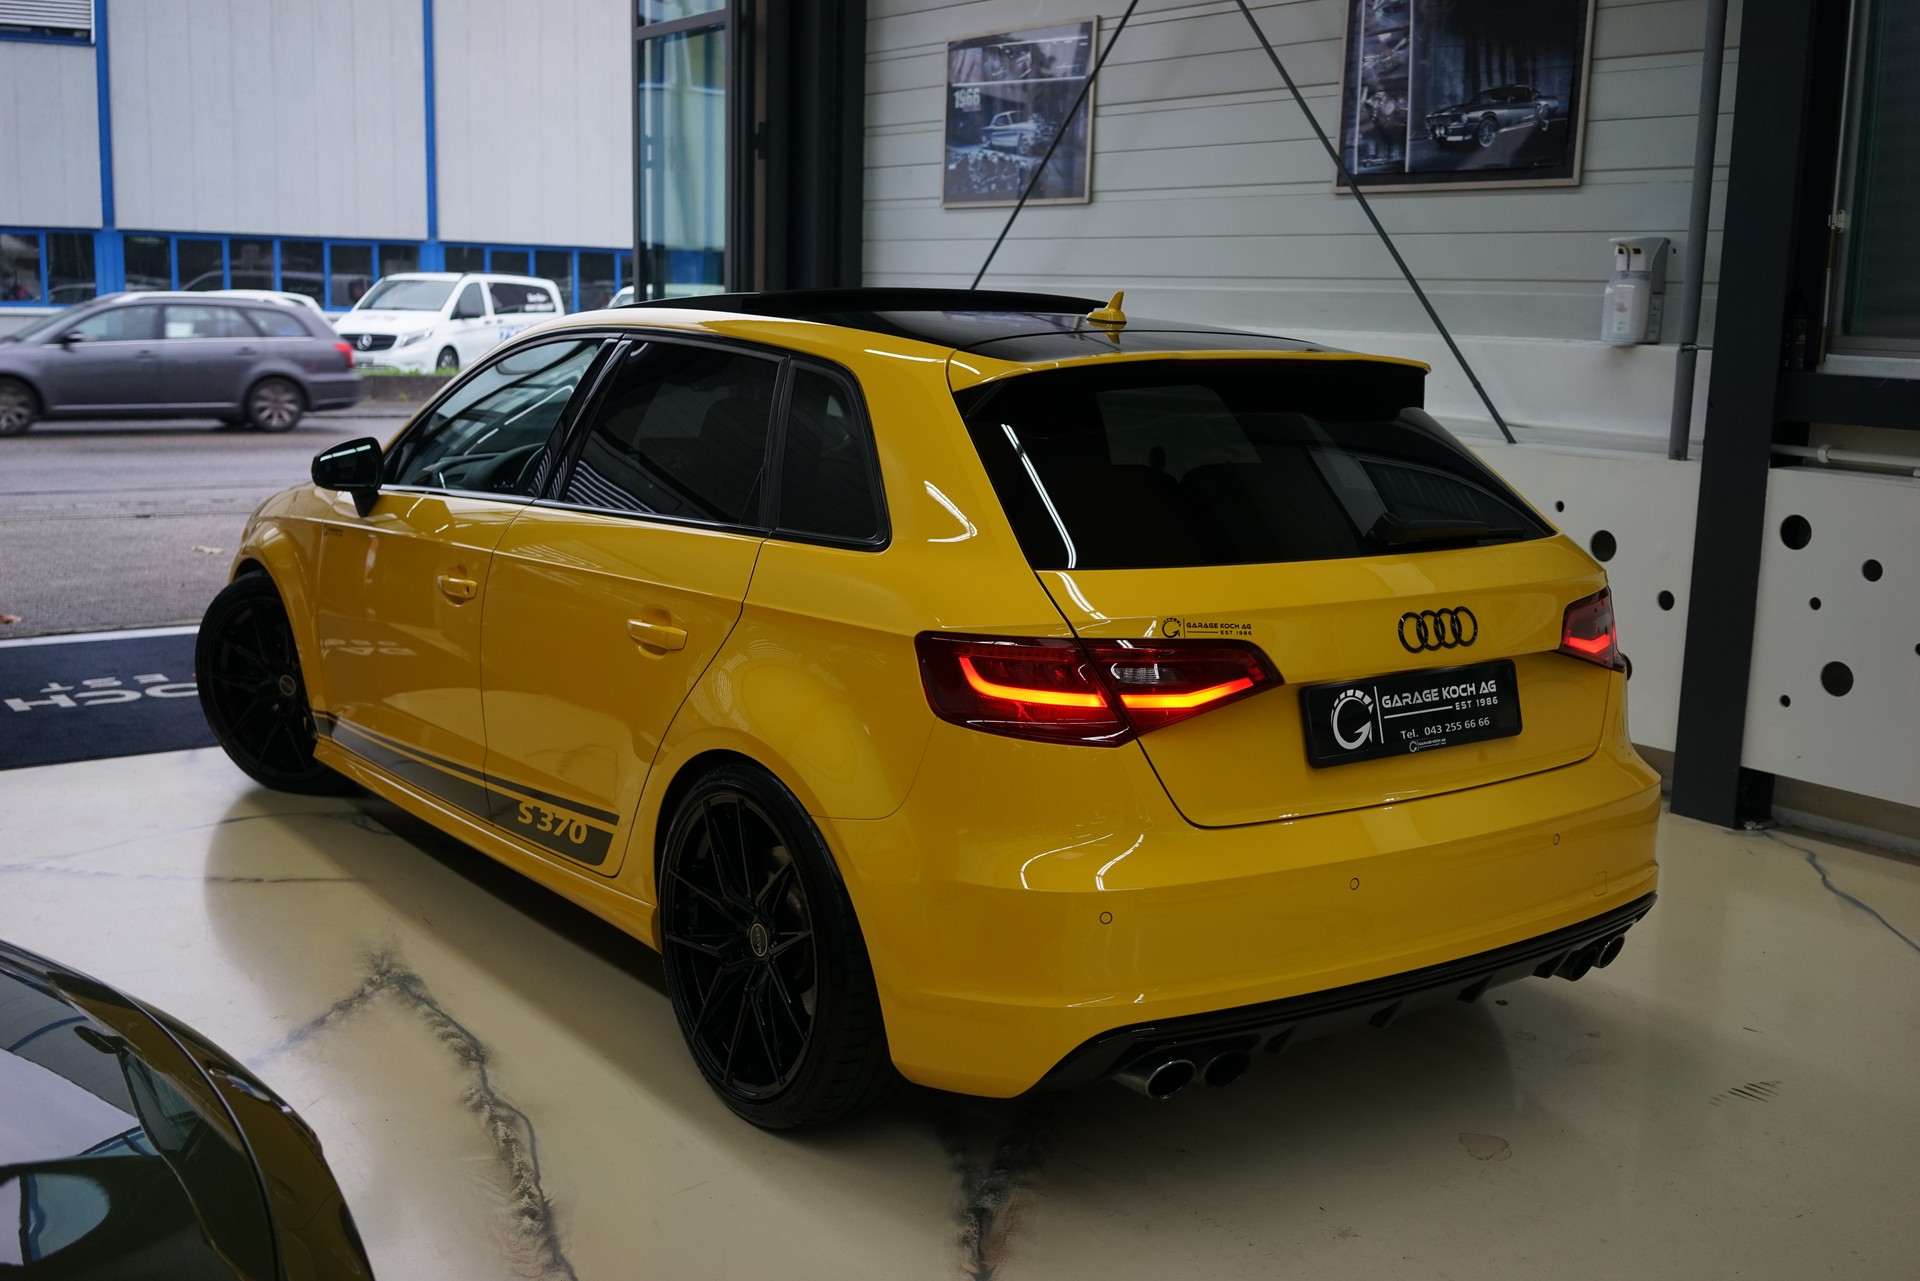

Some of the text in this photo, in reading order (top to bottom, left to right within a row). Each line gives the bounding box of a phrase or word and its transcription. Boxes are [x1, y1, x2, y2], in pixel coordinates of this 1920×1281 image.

[954, 88, 981, 109] 1966
[1381, 679, 1497, 708] GARAGE KOCH AG
[1455, 696, 1499, 711] EST 1986
[1400, 717, 1490, 740] Tel. 043 255 66 66
[517, 801, 588, 845] S370
